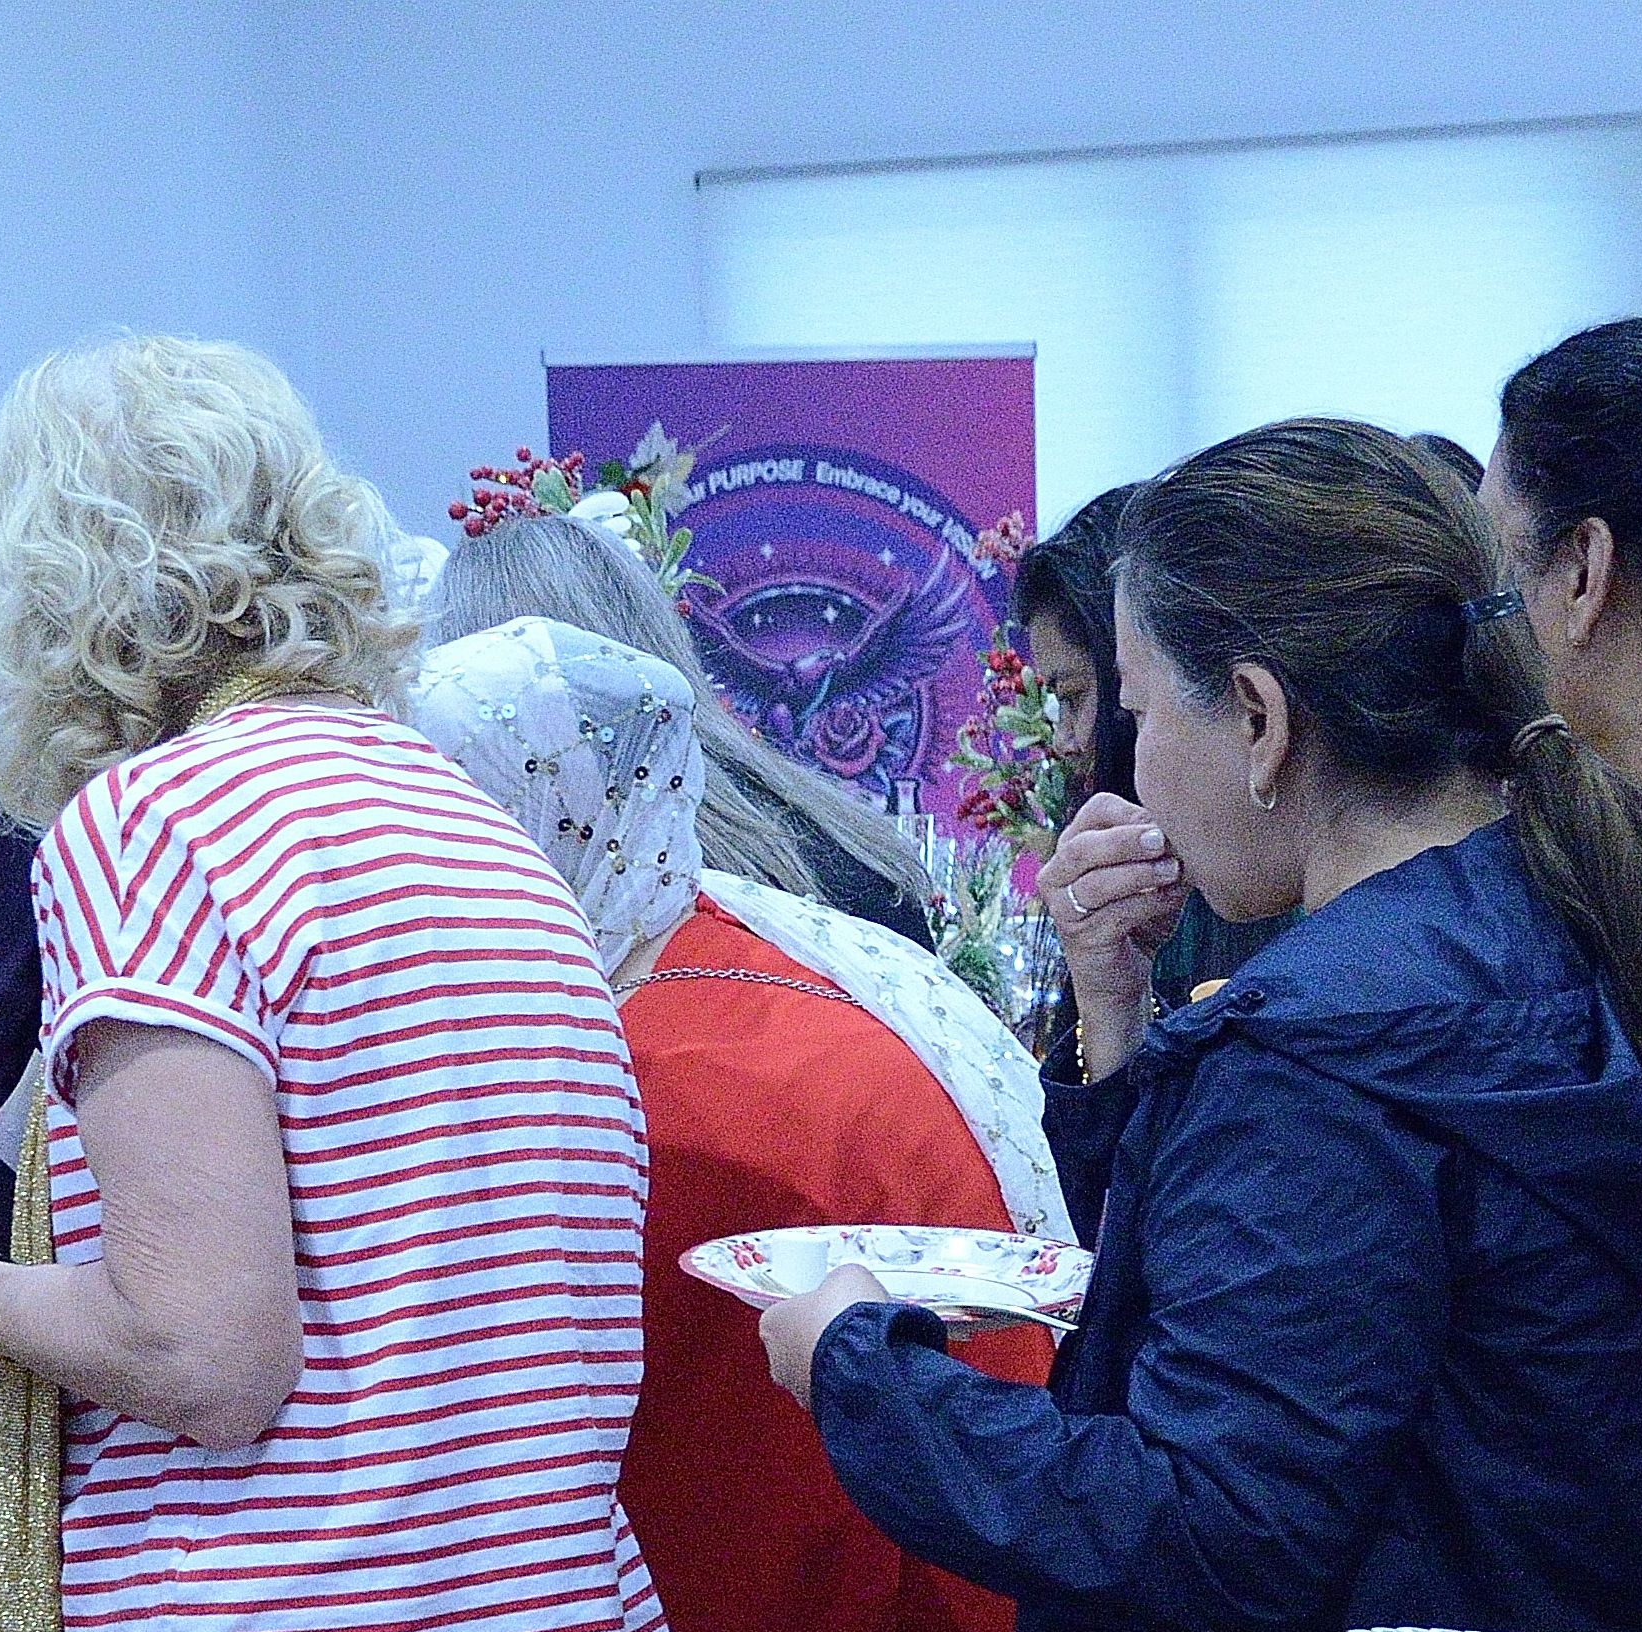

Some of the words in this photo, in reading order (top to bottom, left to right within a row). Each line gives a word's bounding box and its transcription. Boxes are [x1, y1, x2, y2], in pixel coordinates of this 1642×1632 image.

[709, 459, 805, 495] PURPOSE
[815, 461, 900, 503] Embrace
[899, 490, 944, 527] your
